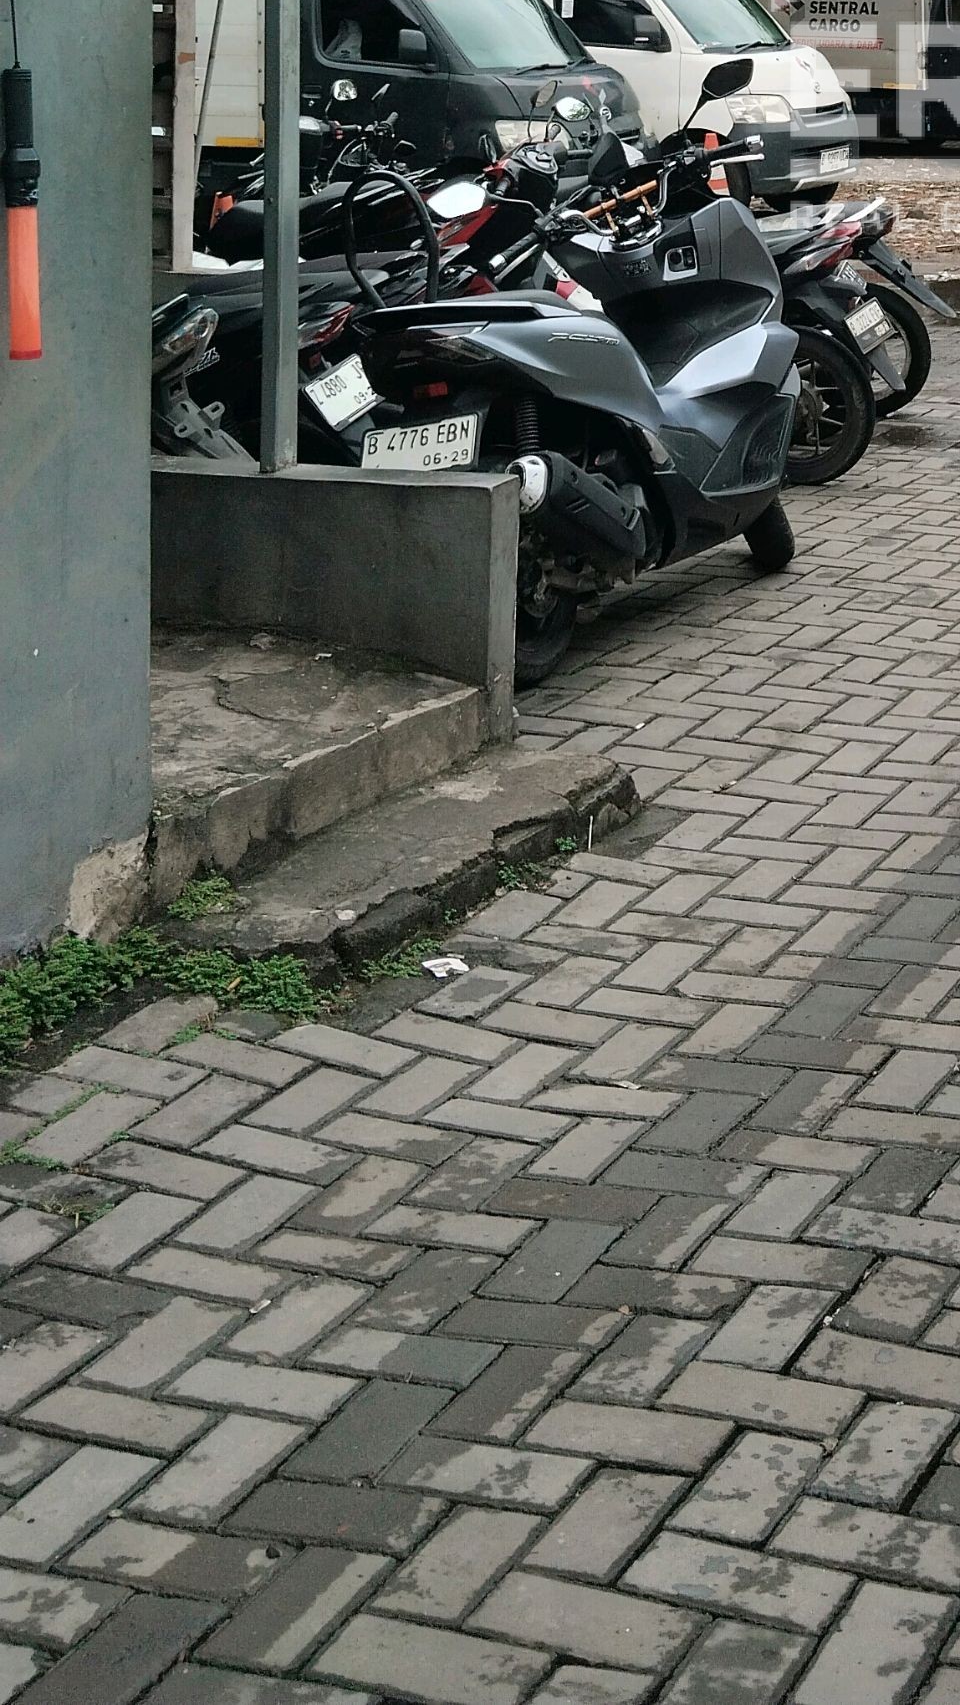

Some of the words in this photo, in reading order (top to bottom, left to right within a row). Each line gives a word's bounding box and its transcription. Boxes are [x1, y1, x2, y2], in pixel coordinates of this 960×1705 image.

[809, 0, 879, 15] SENTRAL
[808, 17, 861, 32] CARGO
[309, 389, 324, 406] Z
[323, 374, 348, 399] 4880
[367, 436, 378, 456] B
[387, 428, 429, 452] 4776
[436, 419, 470, 444] EBN
